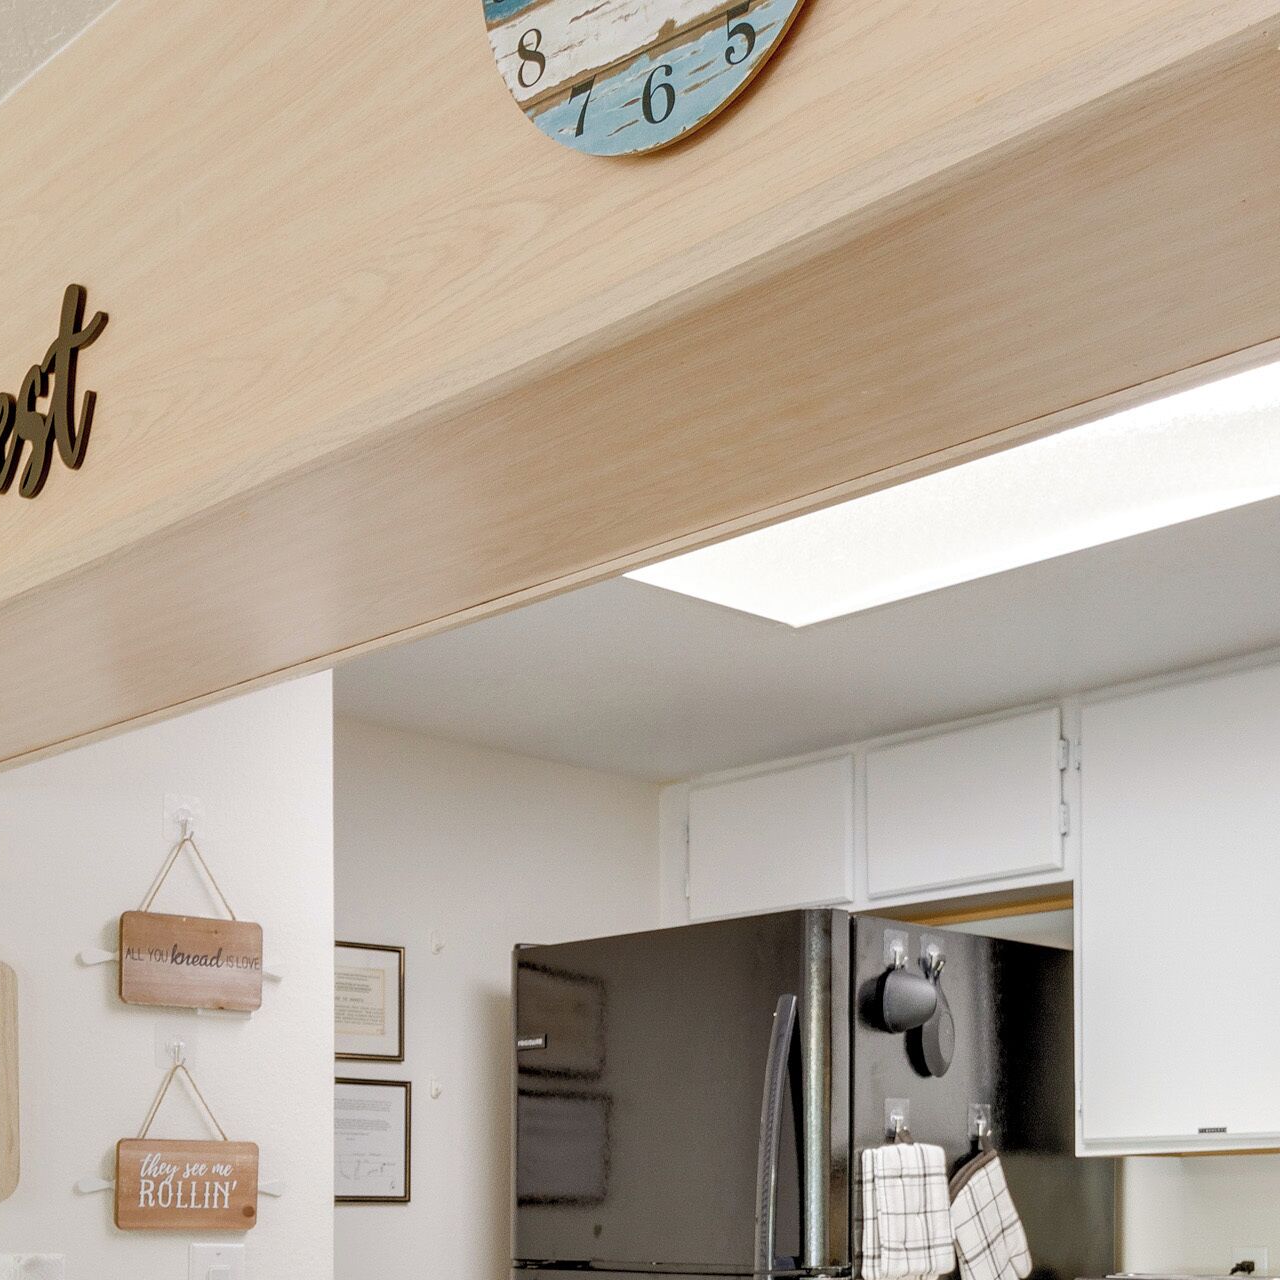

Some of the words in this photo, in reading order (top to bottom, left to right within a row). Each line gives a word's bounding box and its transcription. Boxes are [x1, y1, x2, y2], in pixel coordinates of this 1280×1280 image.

[517, 28, 547, 88] 8
[725, 0, 756, 65] 5
[569, 74, 596, 138] 7
[642, 64, 676, 124] 6
[125, 947, 145, 961] ALL
[148, 948, 169, 963] YOU
[170, 943, 225, 968] knead
[226, 955, 235, 968] IS
[236, 956, 261, 970] LOVE
[138, 1178, 238, 1209] ROLLIN'
[139, 1152, 179, 1184] they
[183, 1161, 209, 1178] see
[211, 1162, 233, 1177] me
